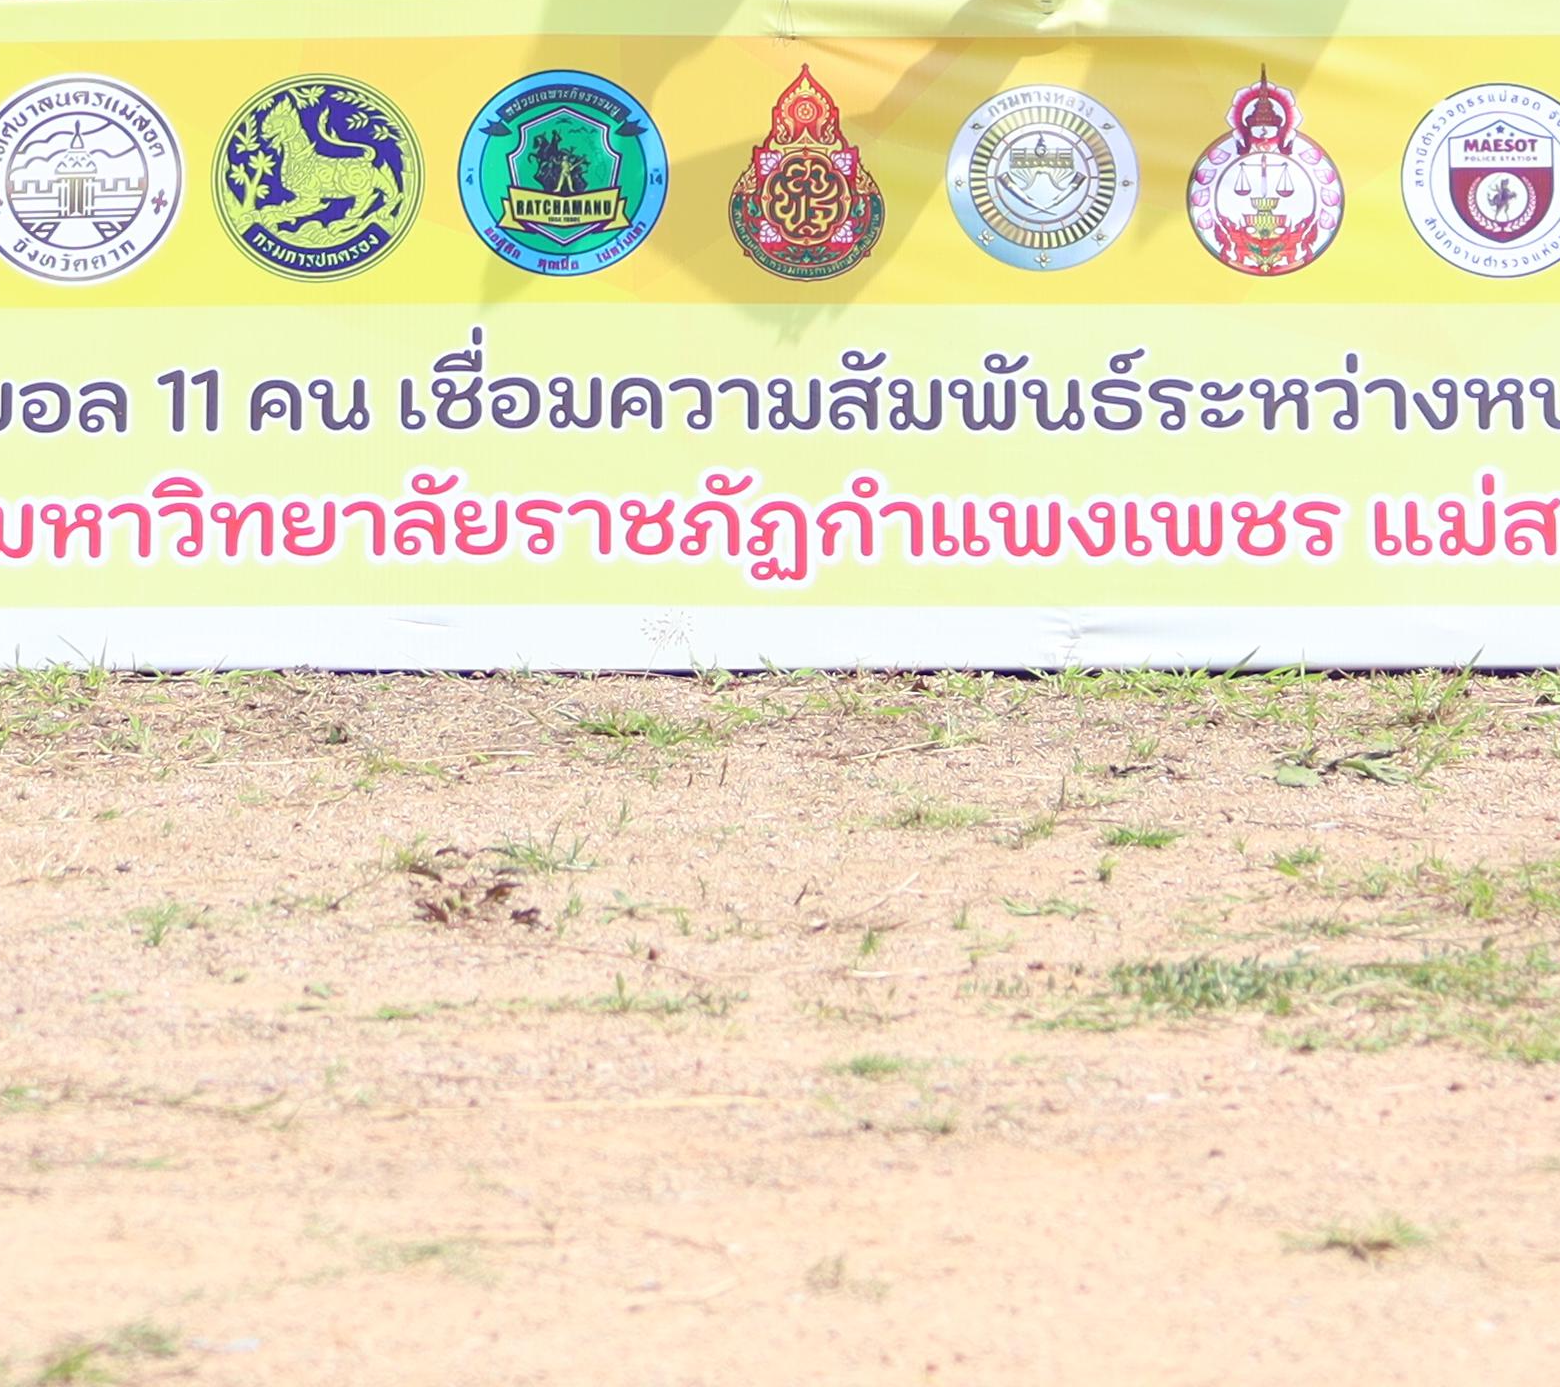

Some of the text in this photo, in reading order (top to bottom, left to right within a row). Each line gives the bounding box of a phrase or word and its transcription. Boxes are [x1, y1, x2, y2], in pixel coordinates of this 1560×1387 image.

[987, 90, 1095, 118] กรมทางหลวง
[1464, 139, 1538, 153] MAESOT
[516, 199, 612, 216] RATCHAMANU
[12, 236, 137, 273] จังหวัดตาก
[252, 231, 381, 268] กรมการปกครอง
[158, 370, 217, 432] 11
[251, 380, 369, 432] คน
